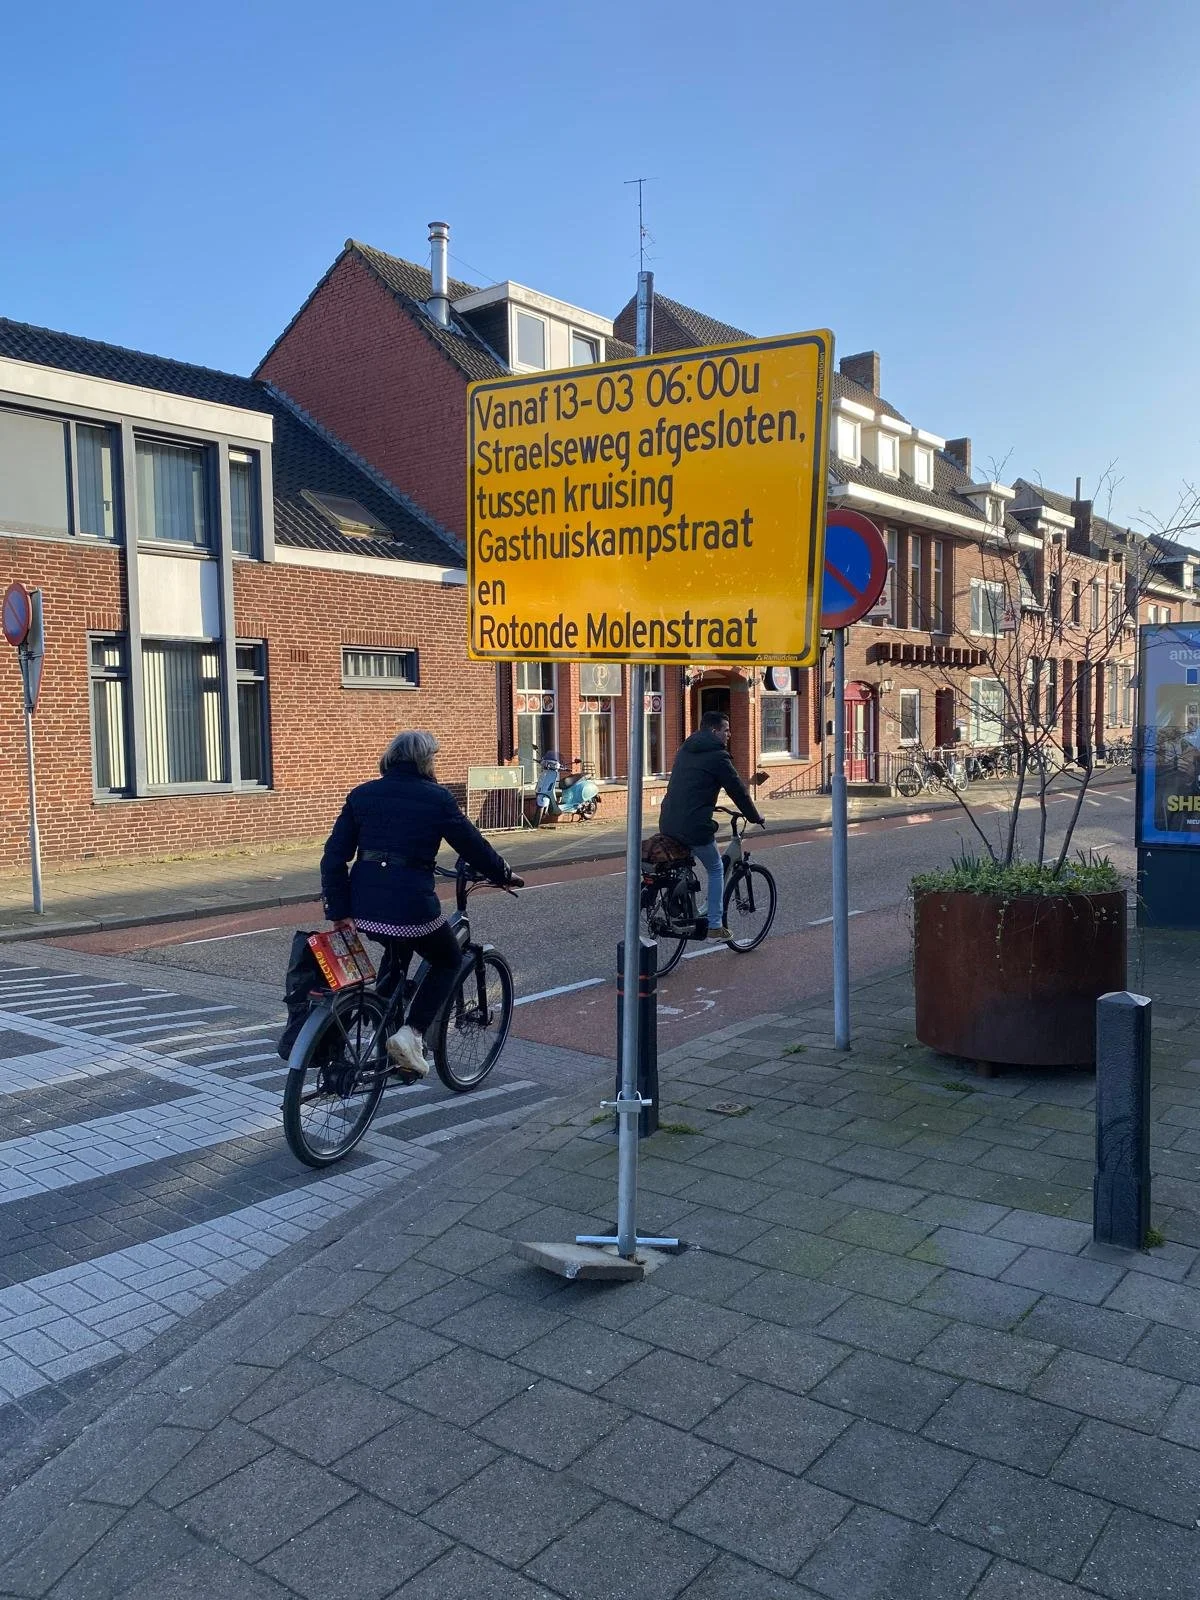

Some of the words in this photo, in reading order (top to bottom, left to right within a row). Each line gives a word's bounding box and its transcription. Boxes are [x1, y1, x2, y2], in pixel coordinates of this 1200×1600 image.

[476, 389, 548, 431] Vanaf
[553, 374, 634, 421] 13-03
[646, 357, 760, 407] 06:00u
[477, 430, 631, 473] Straelseweg
[638, 406, 806, 466] afgesloten,
[477, 487, 556, 520] tussen
[564, 472, 674, 517] kruising
[478, 508, 754, 562] Gasthuiskampstraat
[478, 579, 506, 606] en
[480, 614, 579, 649] Rotonde
[587, 608, 758, 649] Molenstraat
[315, 951, 338, 988] ELECTRO
